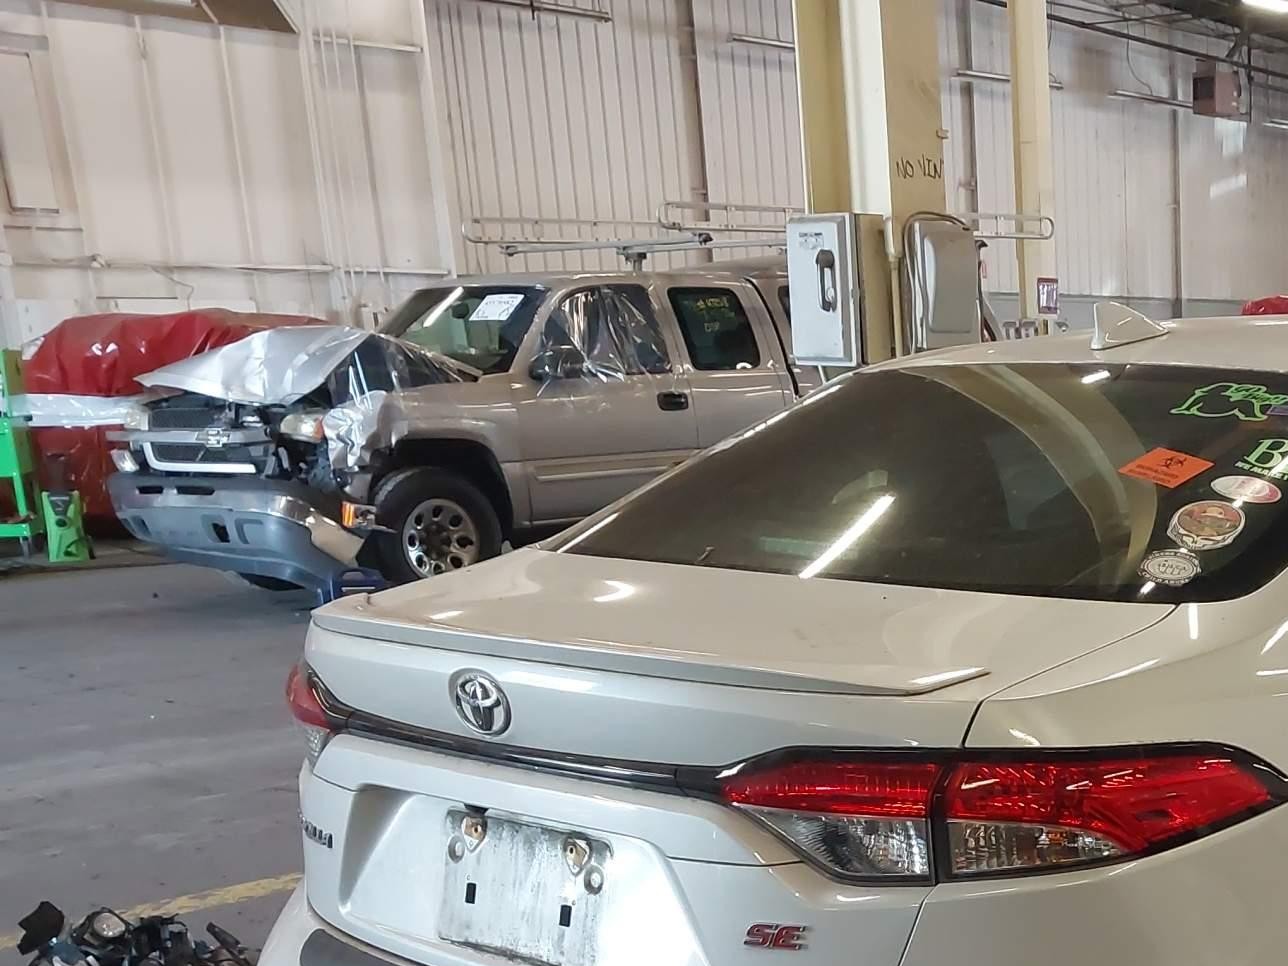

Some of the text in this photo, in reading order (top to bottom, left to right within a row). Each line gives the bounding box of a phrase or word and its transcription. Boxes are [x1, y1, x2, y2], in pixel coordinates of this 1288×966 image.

[896, 156, 914, 179] NO
[1234, 460, 1253, 470] WE
[743, 922, 806, 951] SE
